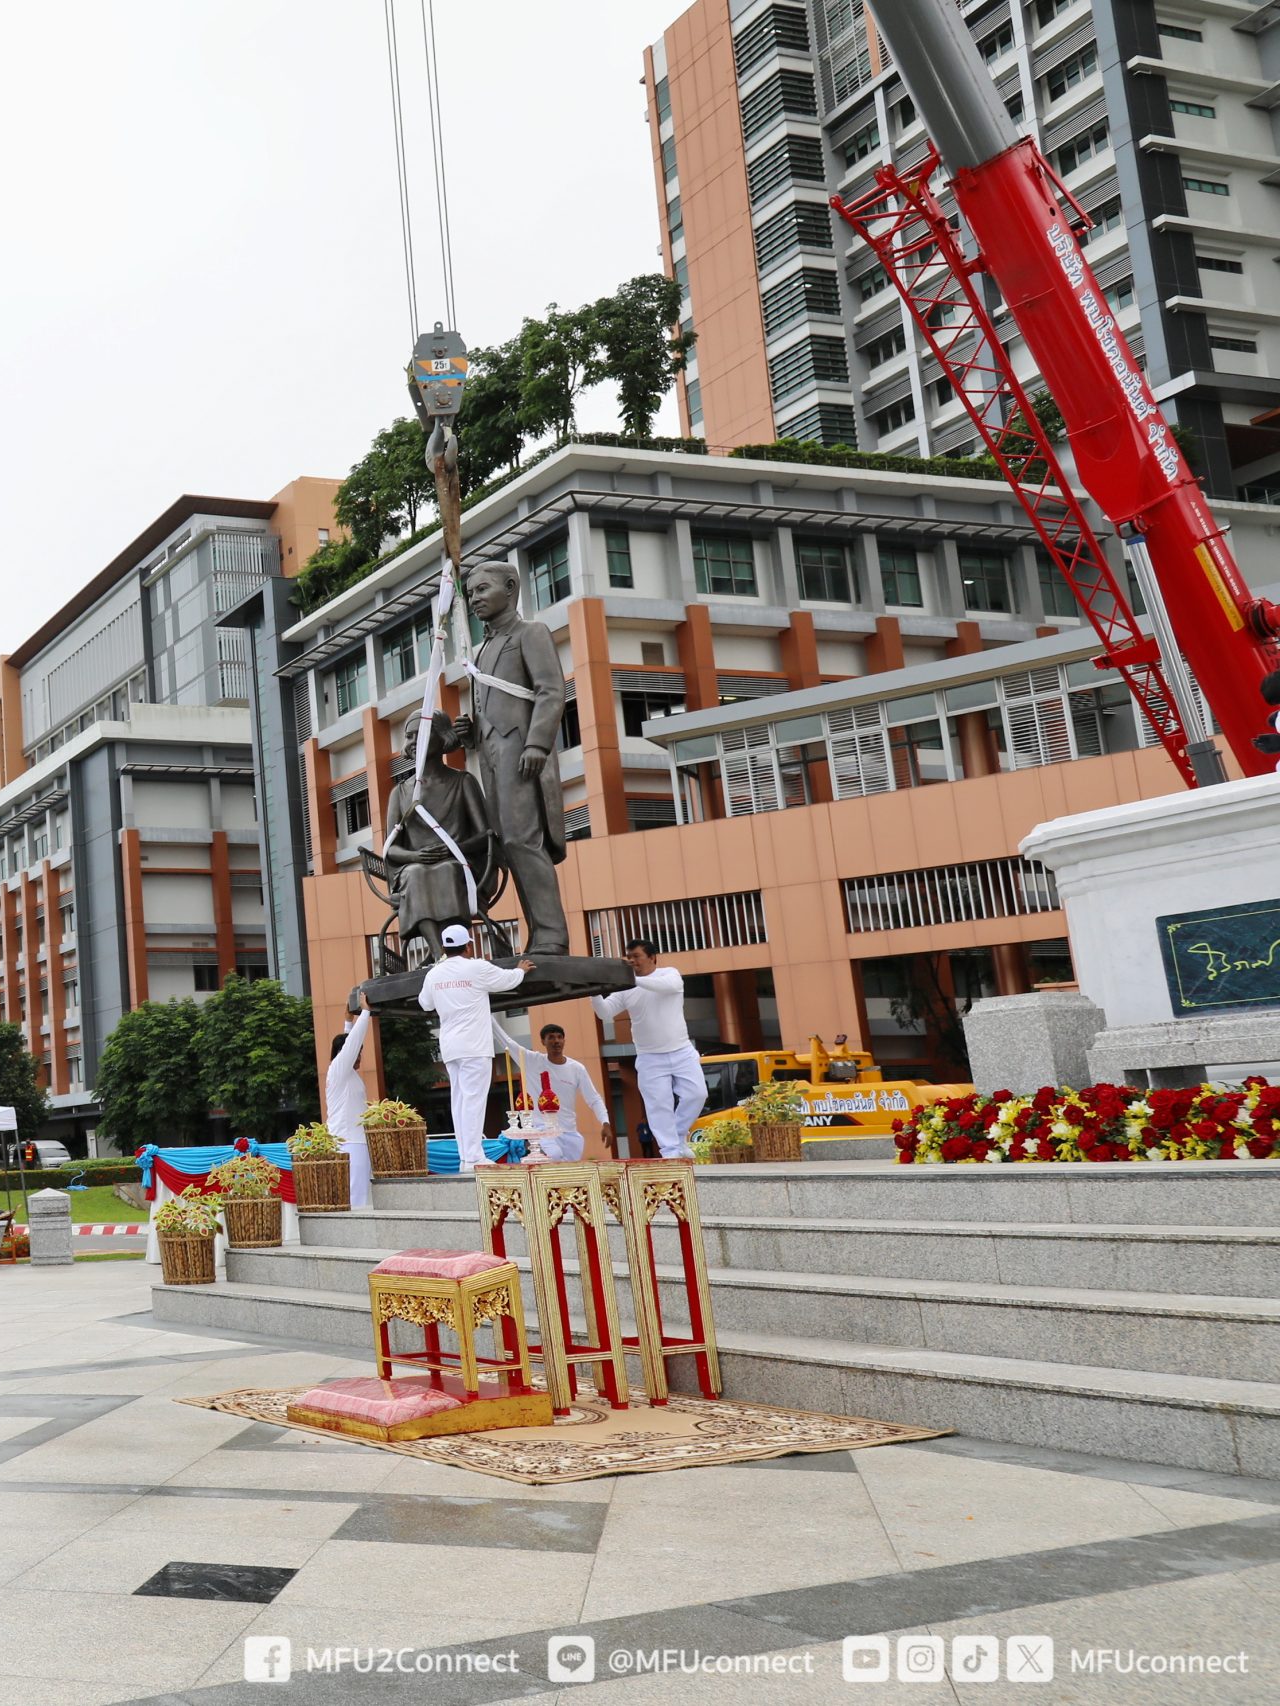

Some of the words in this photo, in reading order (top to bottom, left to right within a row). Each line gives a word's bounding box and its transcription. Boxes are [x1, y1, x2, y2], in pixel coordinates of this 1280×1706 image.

[1047, 224, 1084, 289] บริษัท
[1148, 423, 1179, 482] จำกัด
[879, 1089, 908, 1110] จำกัด
